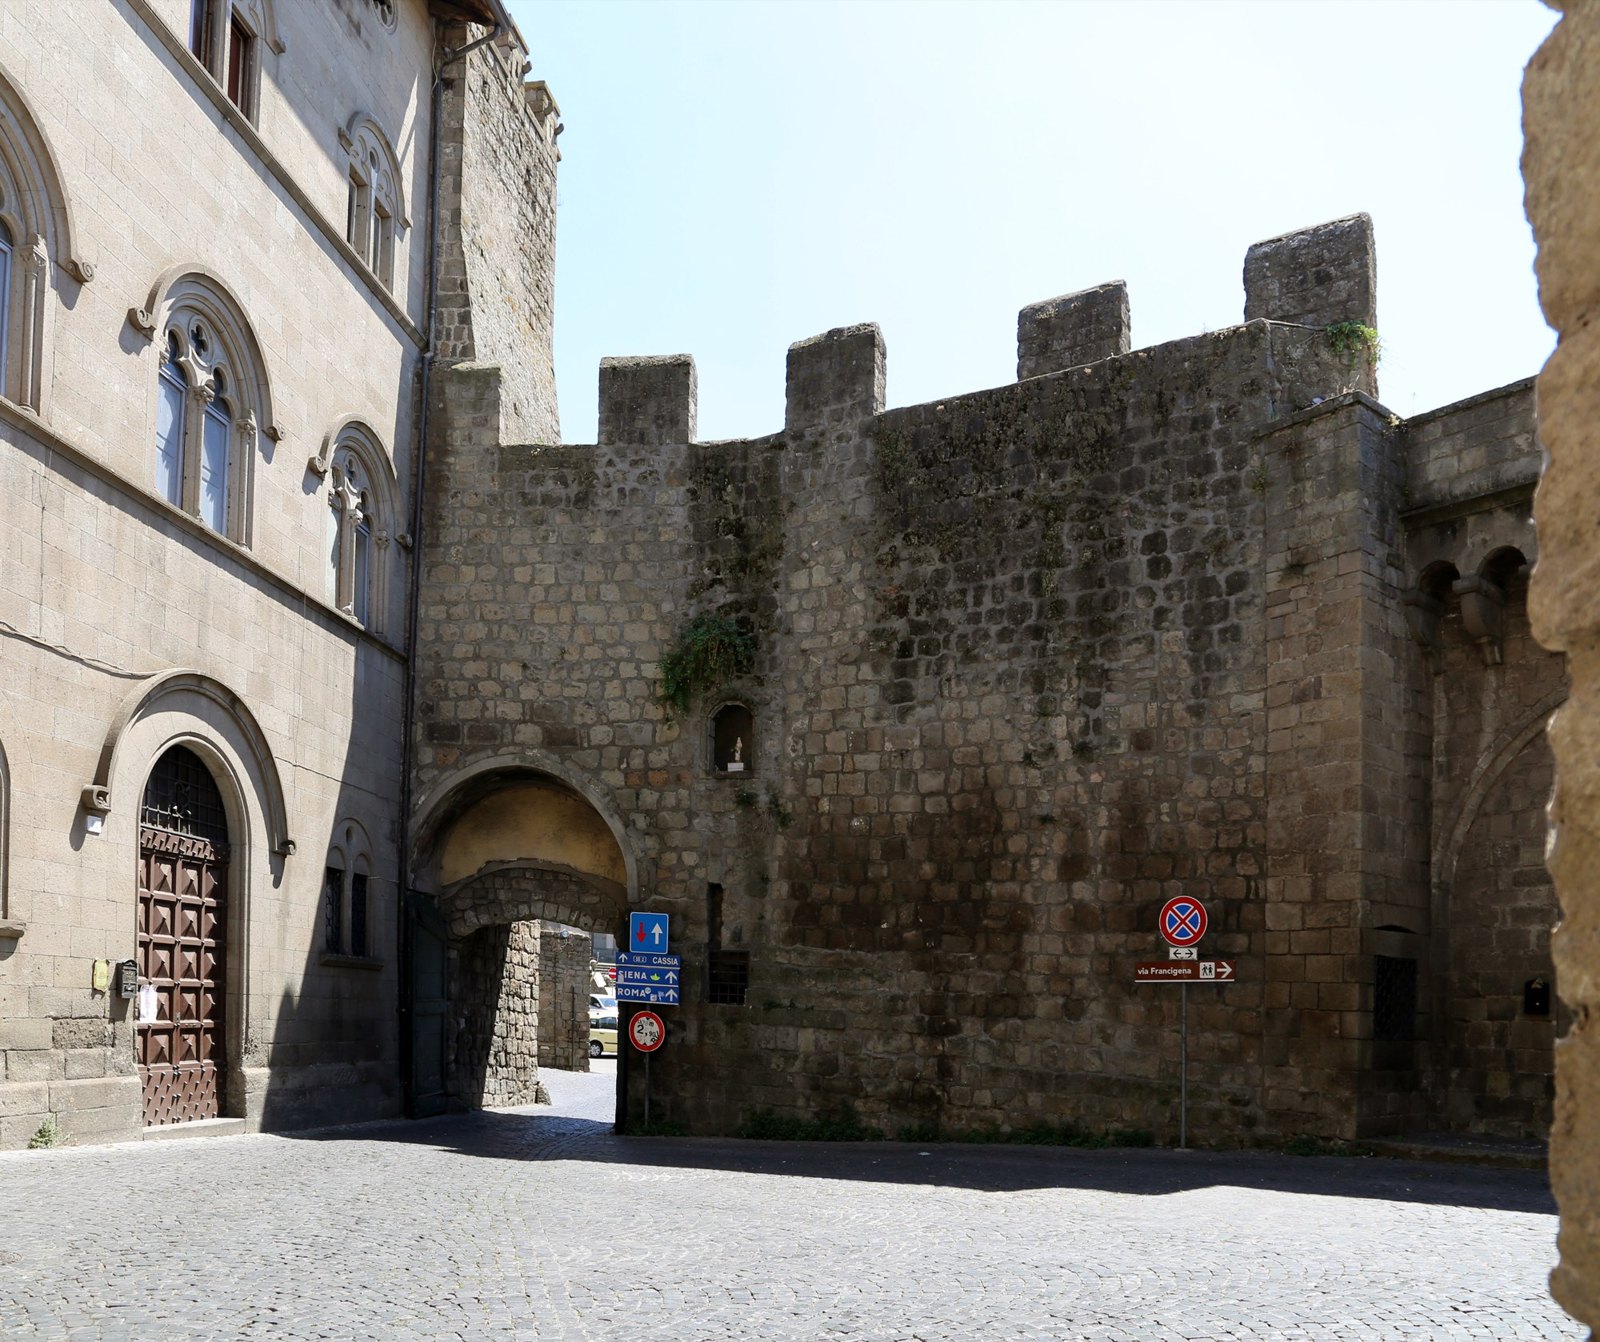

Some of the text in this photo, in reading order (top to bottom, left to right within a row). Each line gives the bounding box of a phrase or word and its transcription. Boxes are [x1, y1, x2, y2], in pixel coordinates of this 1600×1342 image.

[652, 956, 679, 966] CASSIA
[618, 970, 648, 980] SIENA
[1137, 966, 1192, 977] via Francigena
[617, 987, 646, 998] ROMA
